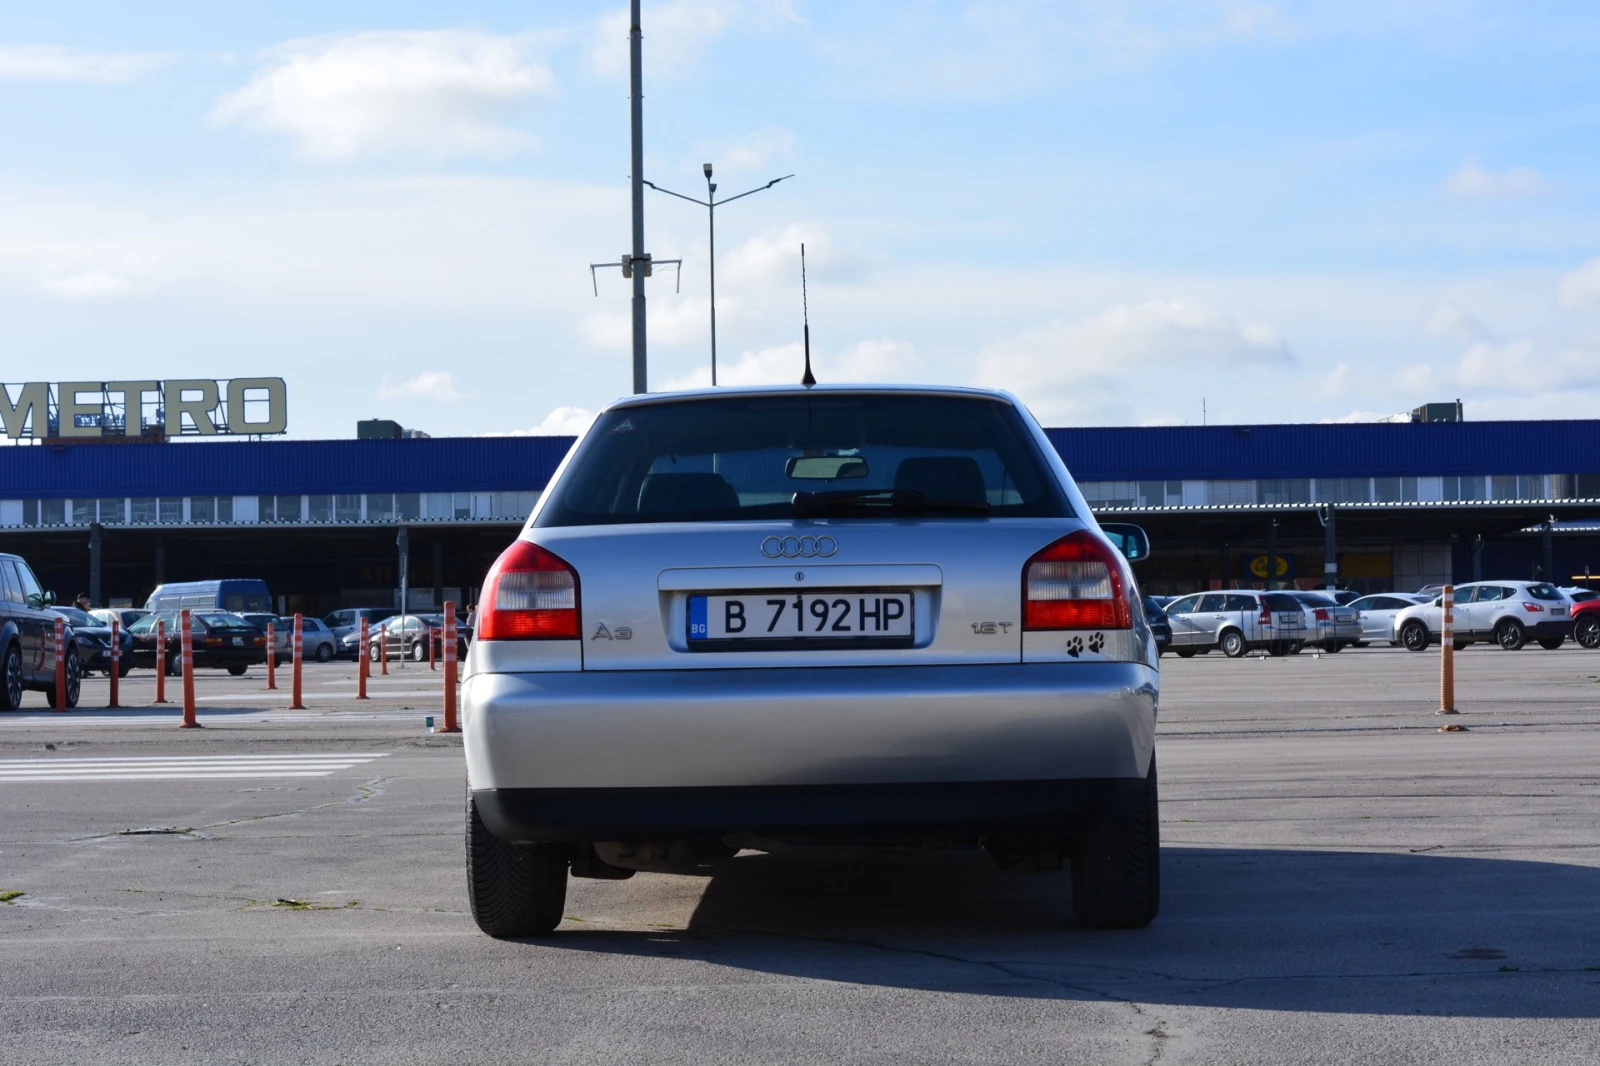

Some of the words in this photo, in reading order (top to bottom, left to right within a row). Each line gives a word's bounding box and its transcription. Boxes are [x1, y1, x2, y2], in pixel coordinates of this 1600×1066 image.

[0, 377, 287, 438] METRO
[691, 623, 706, 634] BG
[725, 601, 746, 633] B
[591, 622, 633, 641] A3
